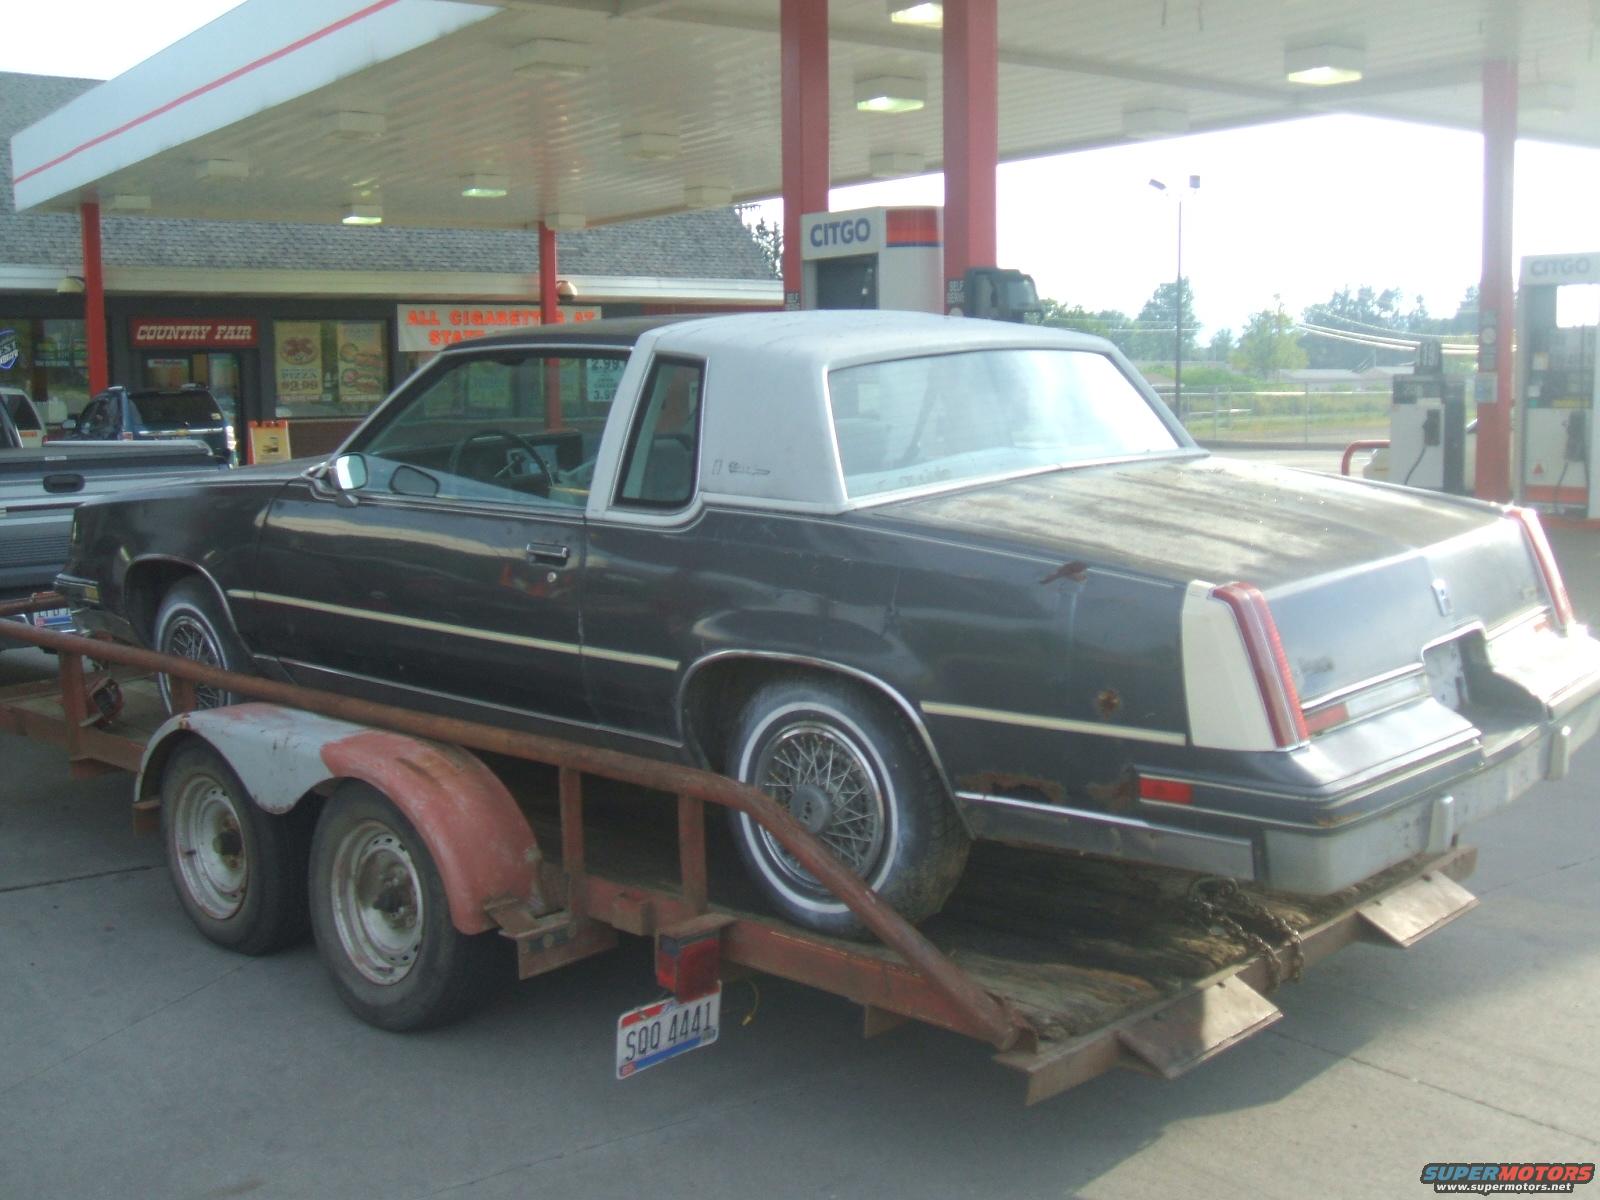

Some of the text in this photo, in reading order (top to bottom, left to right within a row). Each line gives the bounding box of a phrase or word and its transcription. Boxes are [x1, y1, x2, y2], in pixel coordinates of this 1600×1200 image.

[810, 217, 871, 247] CITGO
[1530, 257, 1591, 277] CITGO
[407, 309, 441, 326] ALL
[449, 309, 566, 327] CIGARETTS
[136, 325, 253, 340] COUNTRY FAIR
